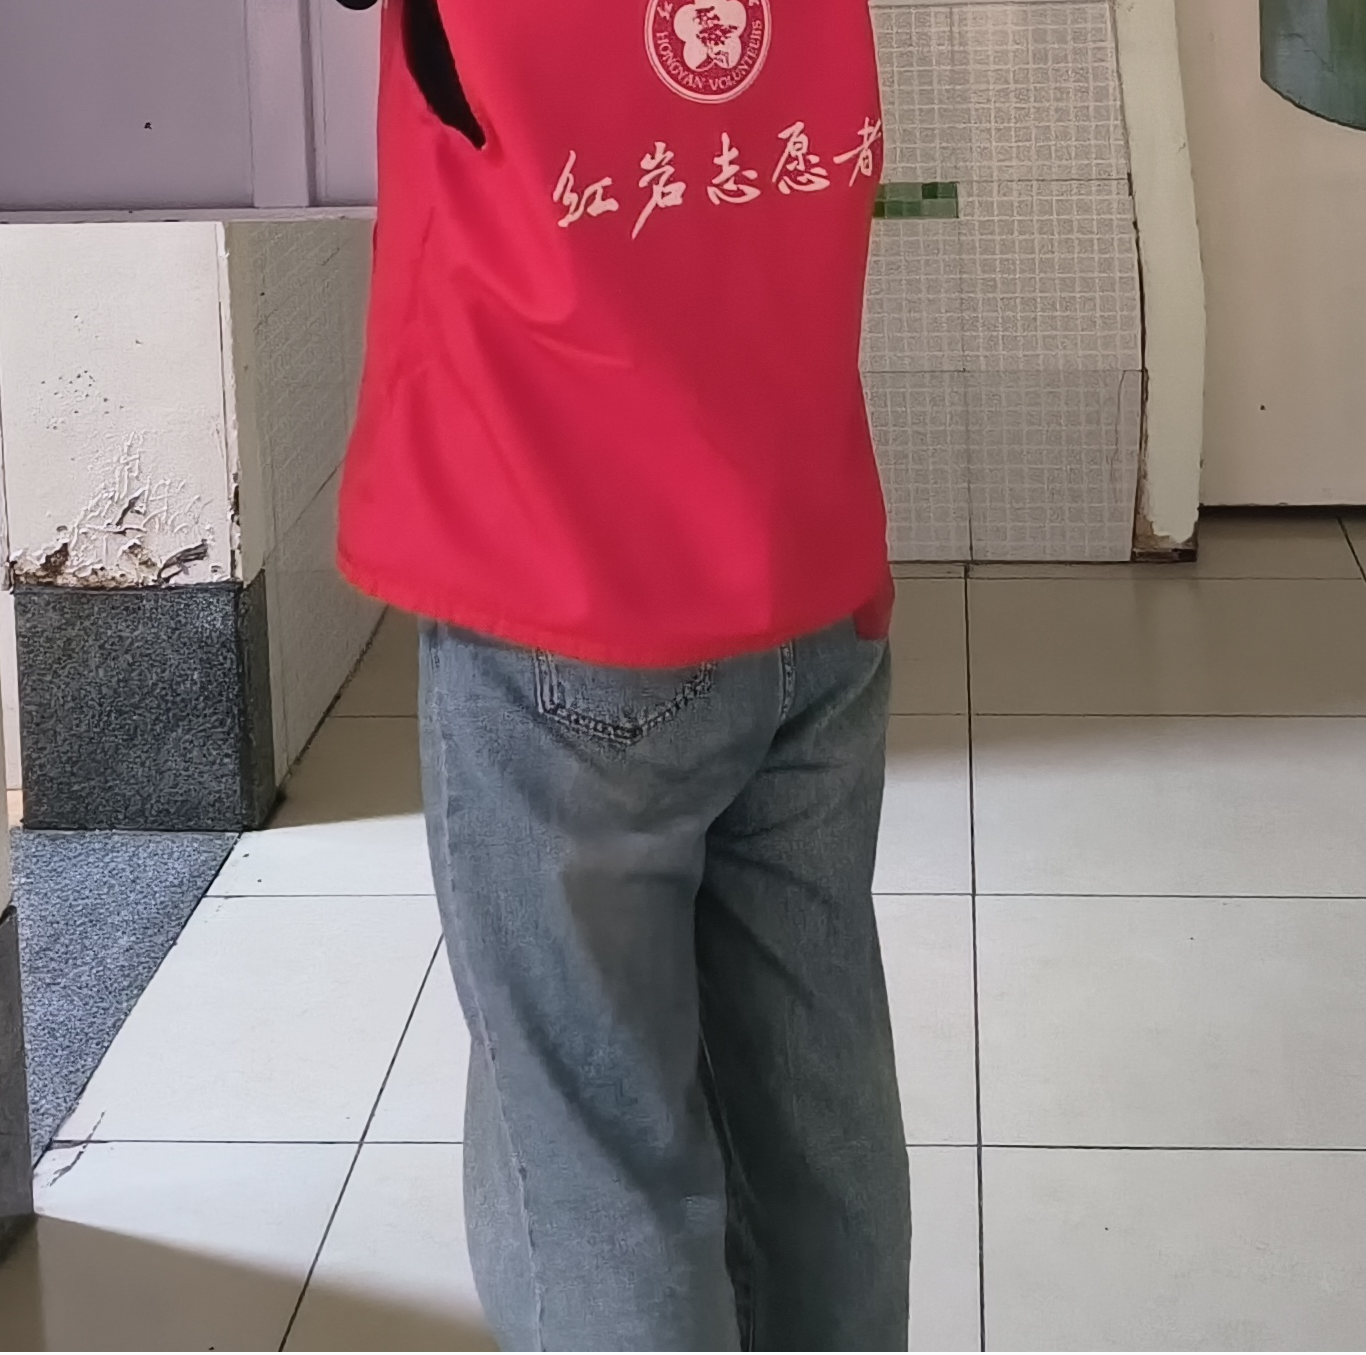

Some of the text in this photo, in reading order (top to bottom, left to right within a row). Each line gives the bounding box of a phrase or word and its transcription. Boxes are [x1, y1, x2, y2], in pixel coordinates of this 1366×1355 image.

[655, 31, 704, 90] HONGYAN
[552, 117, 883, 241] 红岩志愿者
